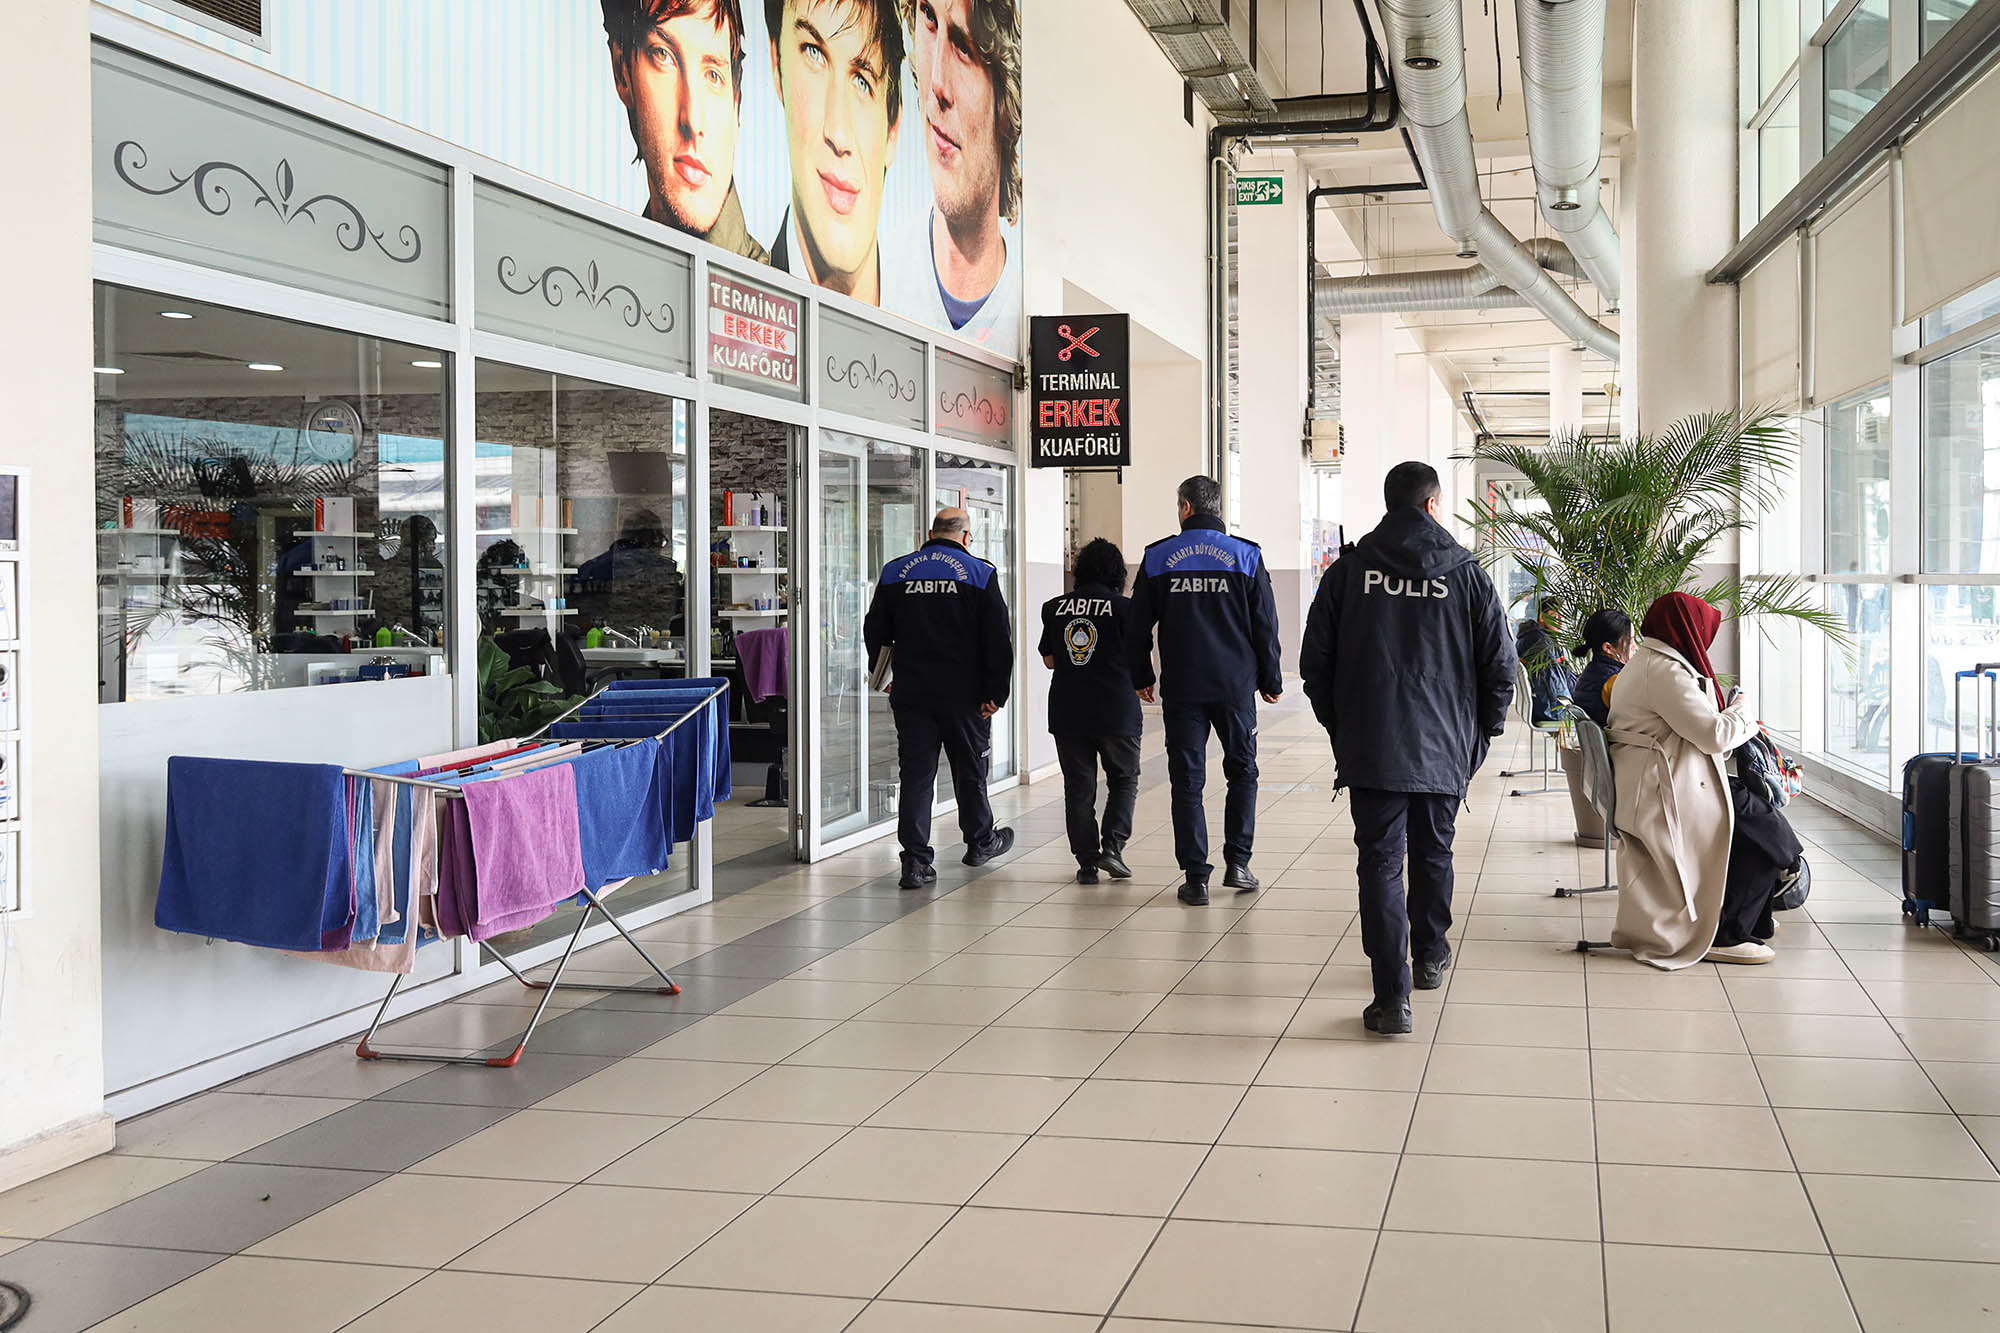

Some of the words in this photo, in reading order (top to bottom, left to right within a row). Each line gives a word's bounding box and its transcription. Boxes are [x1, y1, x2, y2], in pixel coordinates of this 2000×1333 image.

[1239, 192, 1254, 201] EXIT
[710, 282, 796, 329] TERMİNAL
[724, 313, 788, 351] ERKEK
[713, 343, 793, 381] KUAFÖRÜ
[1039, 369, 1121, 391] TERMİNAL
[1039, 399, 1121, 427] ERKEK
[1040, 433, 1121, 457] KUAFÖRÜ
[898, 554, 929, 579] SAKARYA
[1166, 545, 1194, 568] SAKARYA
[905, 580, 958, 594] ZABITA
[1169, 578, 1229, 593] ZABITA
[1055, 598, 1113, 617] ZABITA
